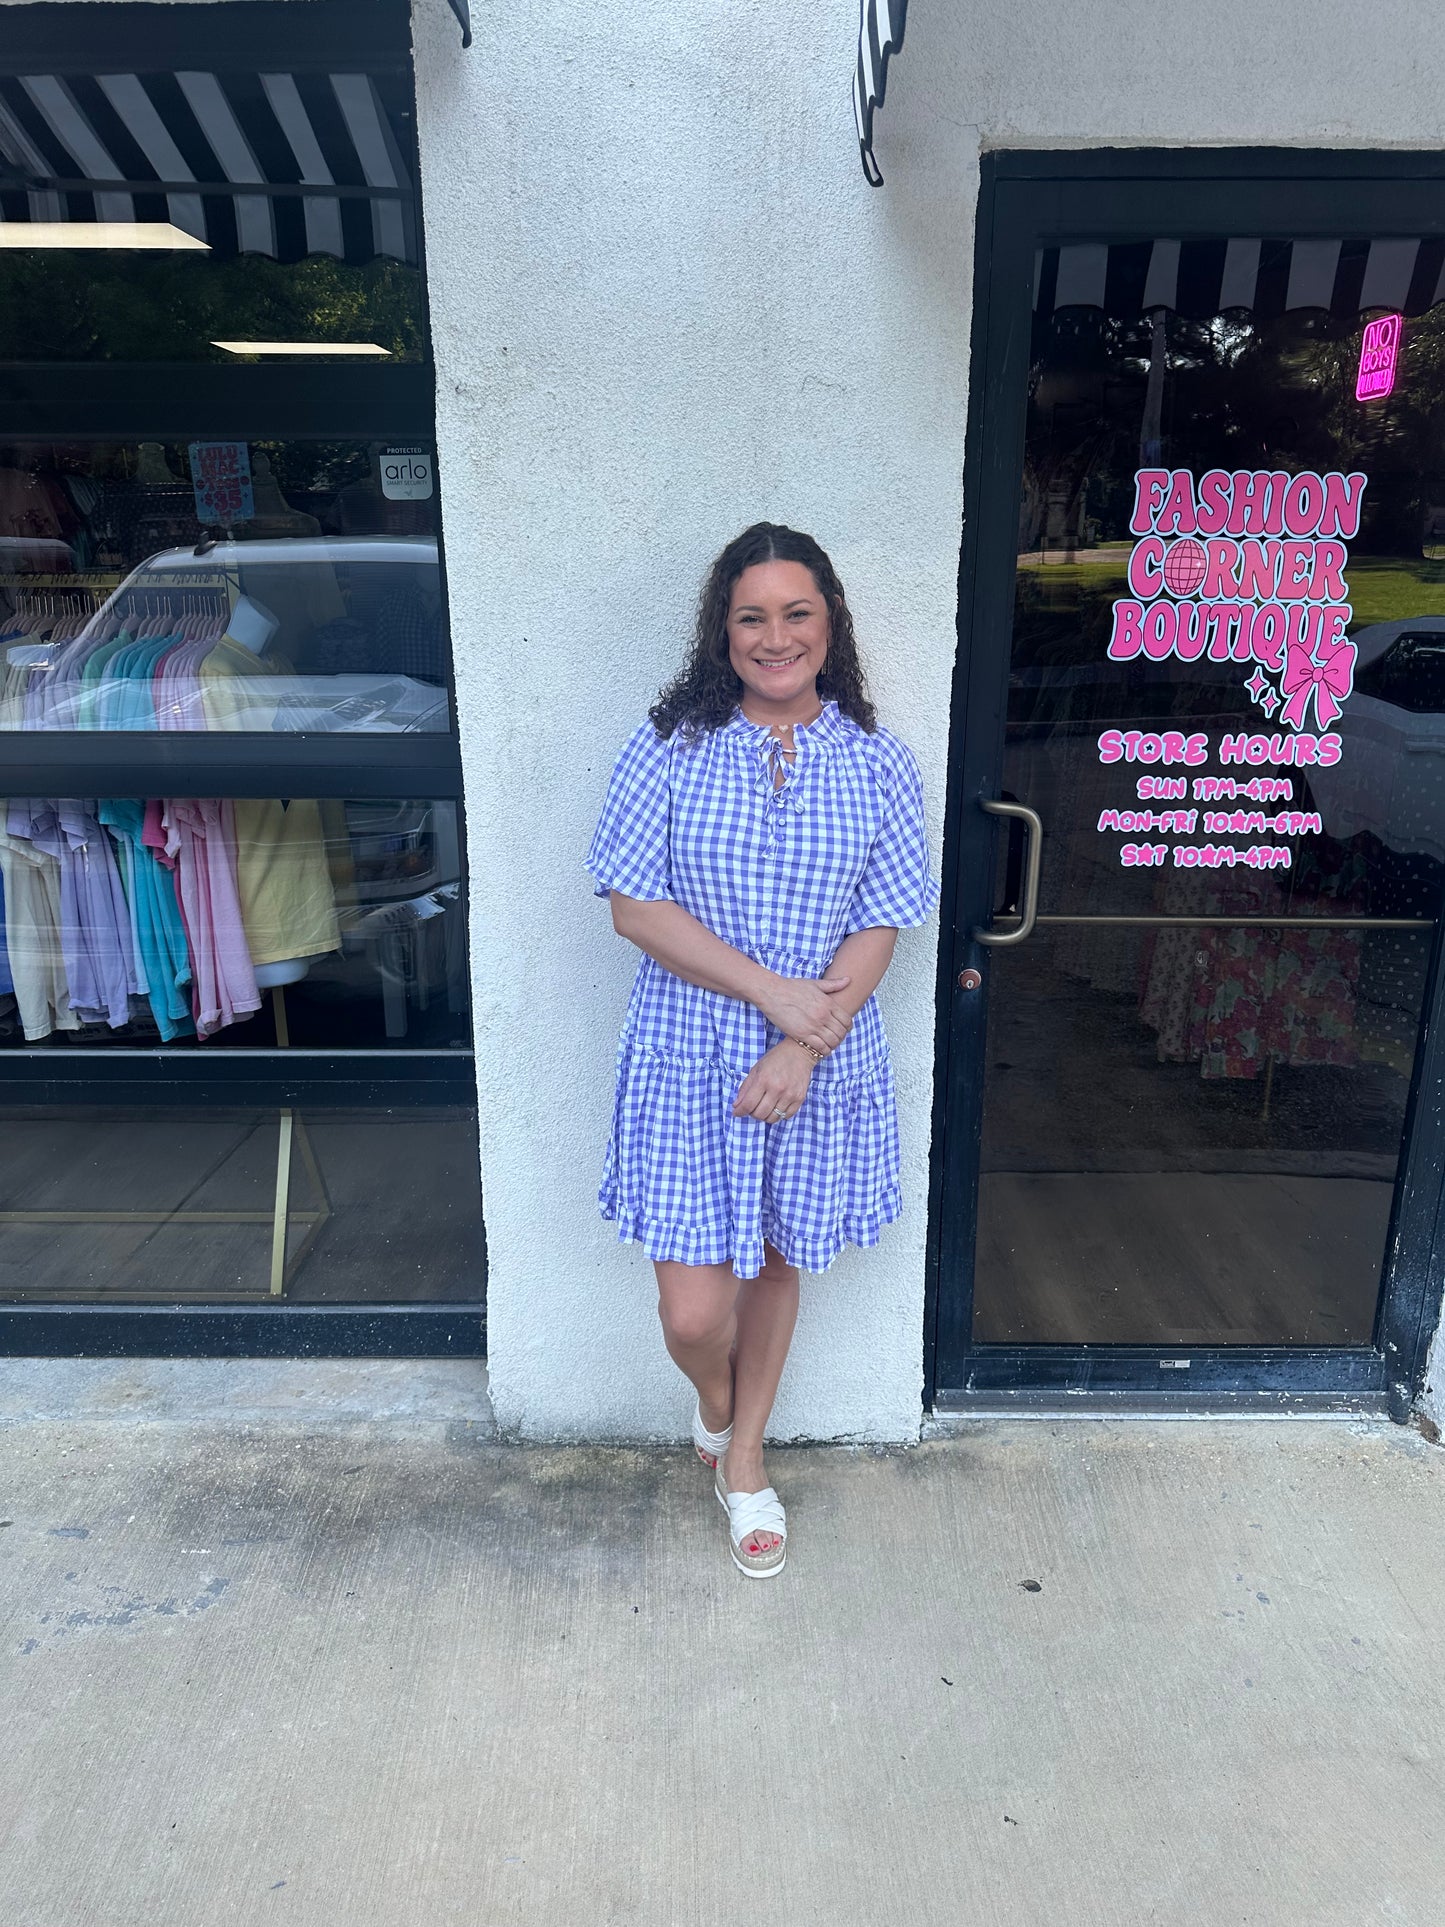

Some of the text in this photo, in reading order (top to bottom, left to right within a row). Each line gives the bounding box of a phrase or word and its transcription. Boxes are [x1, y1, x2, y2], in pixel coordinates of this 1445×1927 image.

[1368, 321, 1392, 351] NO
[1363, 347, 1391, 372] BOYS
[385, 458, 428, 480] arlo
[204, 489, 242, 512] $35
[1130, 469, 1367, 539] FASHION
[1128, 535, 1349, 602] CORNER
[1107, 598, 1353, 672] BOUTIQUE
[1098, 729, 1342, 767] STORE HOURS
[1136, 775, 1293, 802] SUN 1PM-4PM
